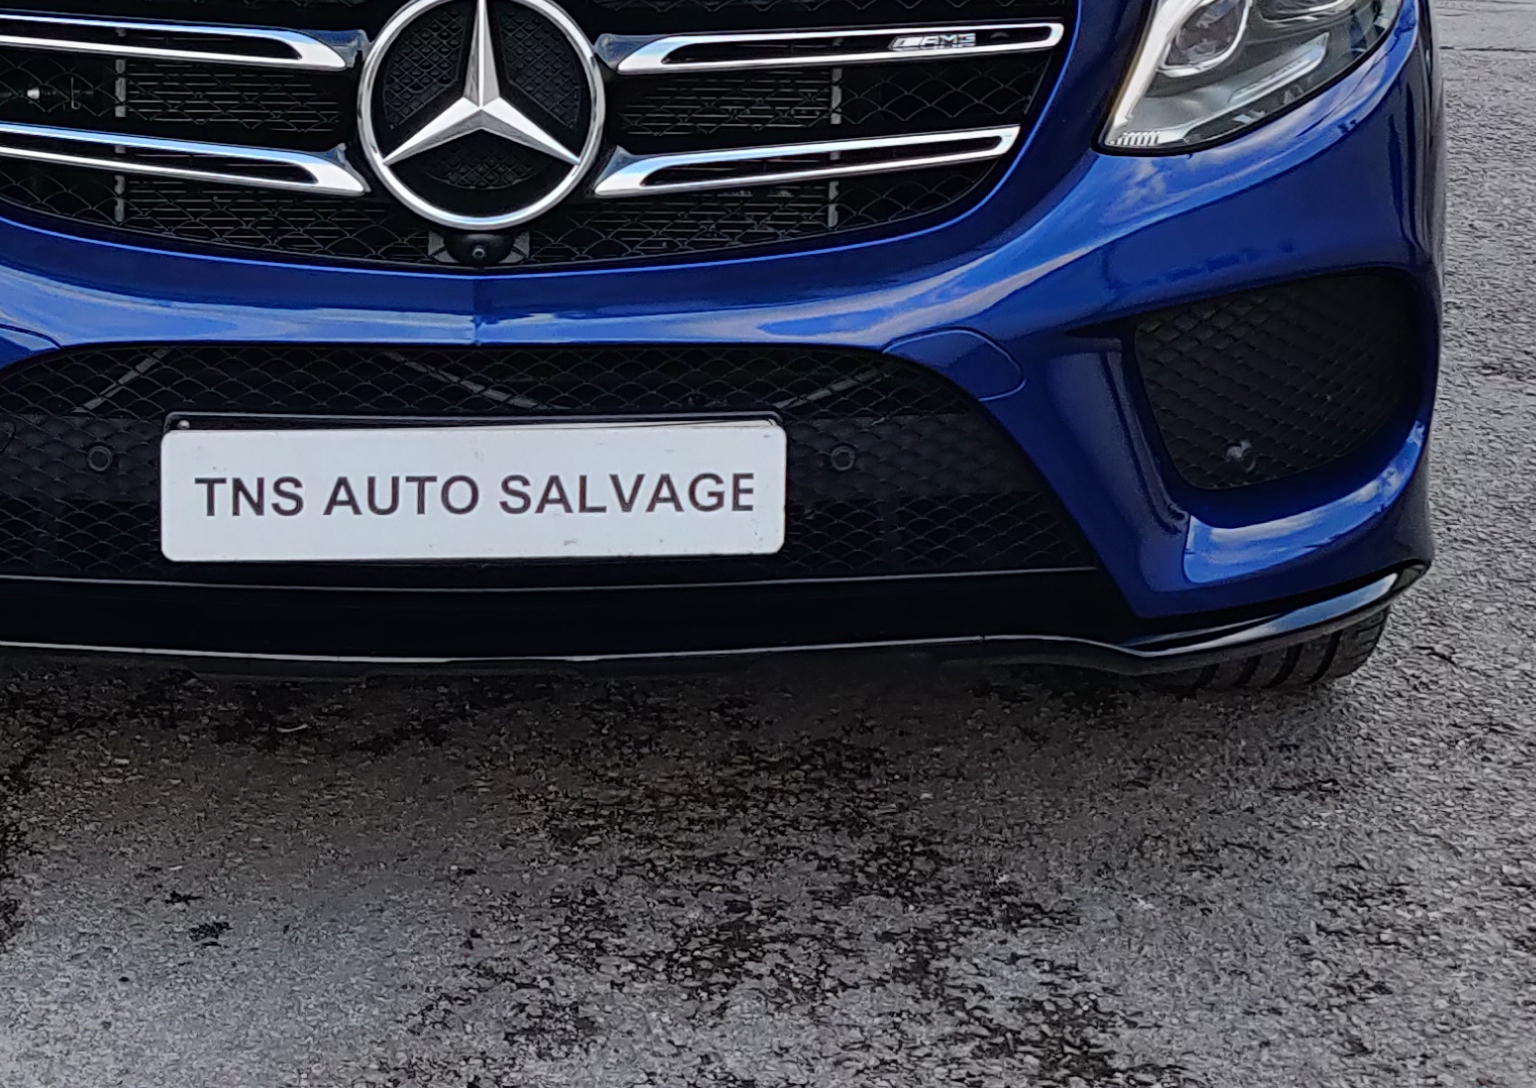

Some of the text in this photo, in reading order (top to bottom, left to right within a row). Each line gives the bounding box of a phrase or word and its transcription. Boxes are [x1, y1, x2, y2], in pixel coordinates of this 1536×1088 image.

[194, 472, 755, 516] TNS AUTO SALVAGE
